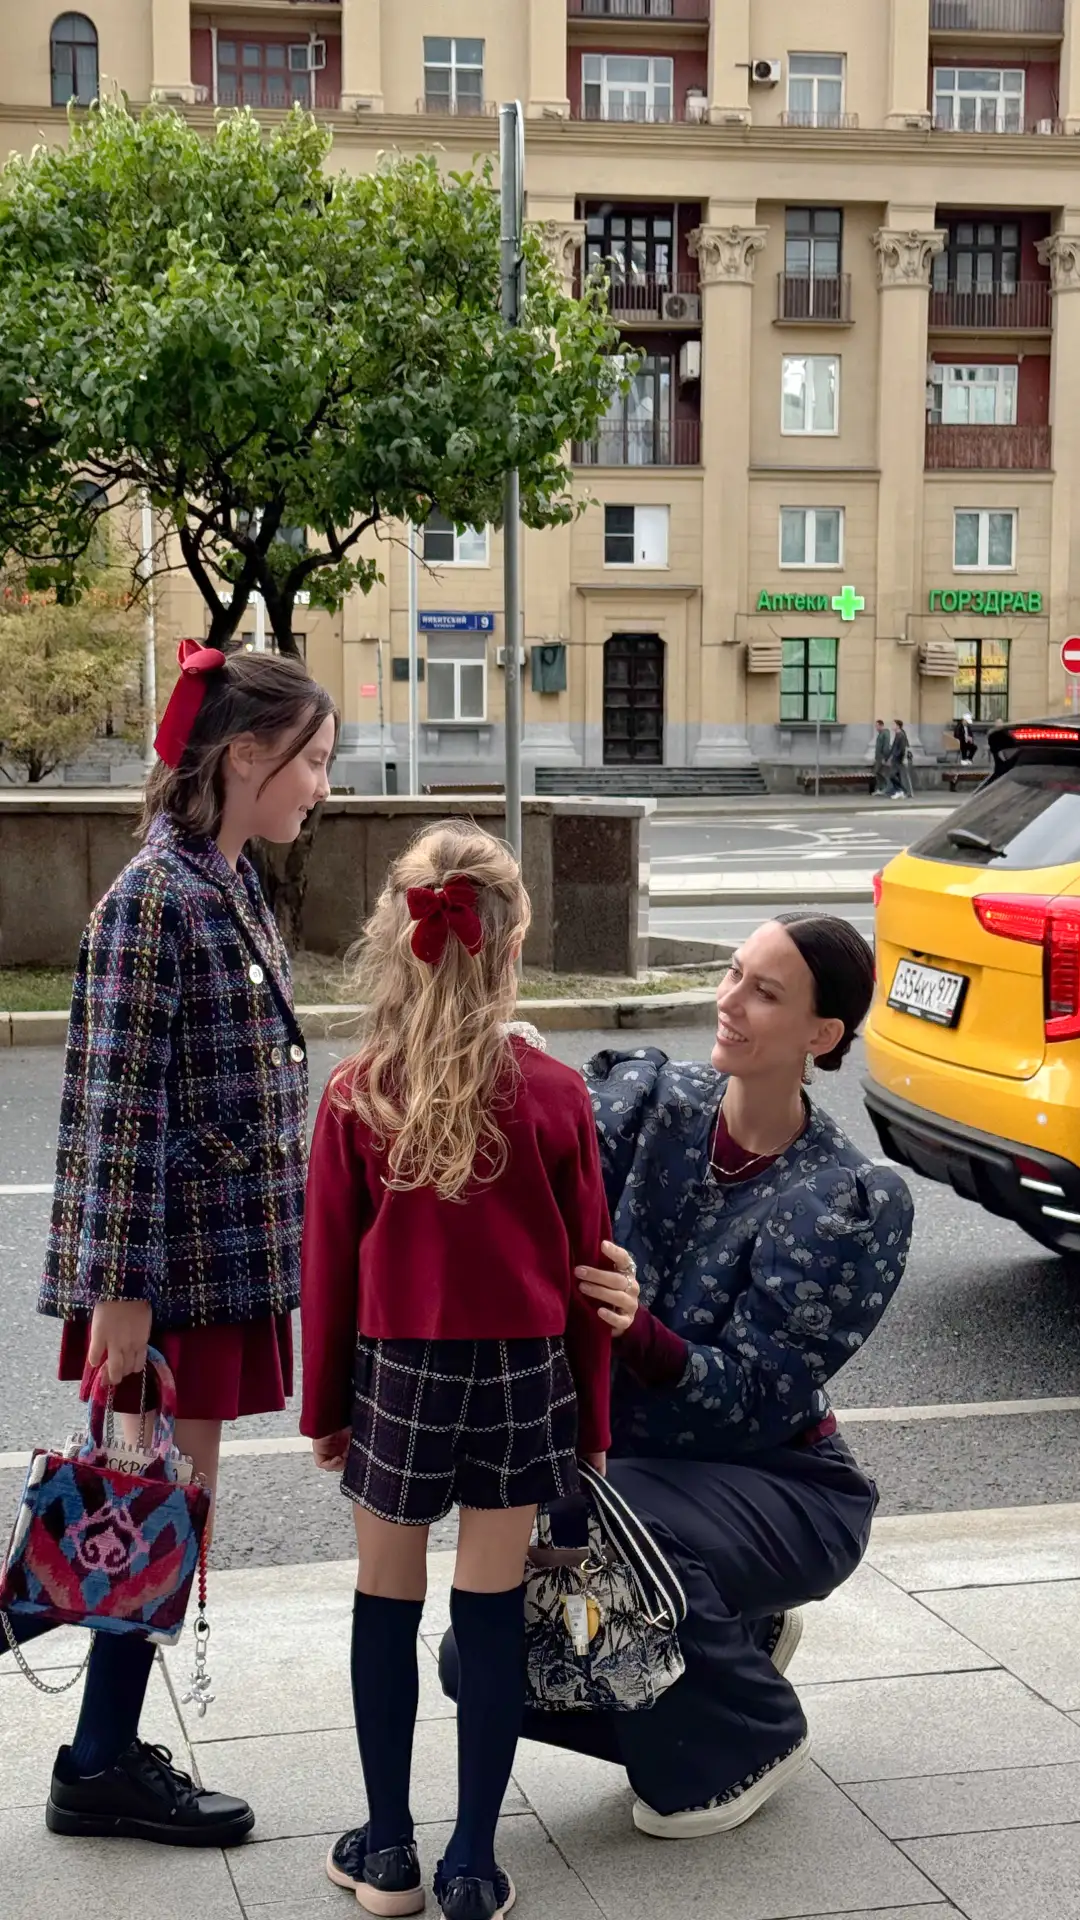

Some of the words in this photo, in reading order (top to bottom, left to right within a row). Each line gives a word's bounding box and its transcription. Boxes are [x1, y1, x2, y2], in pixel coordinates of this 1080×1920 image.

[757, 589, 829, 611] Аптеки
[929, 590, 1042, 615] ГОРЗДРАВ
[422, 615, 467, 624] НИКИТСКИЙ
[481, 616, 489, 628] 9
